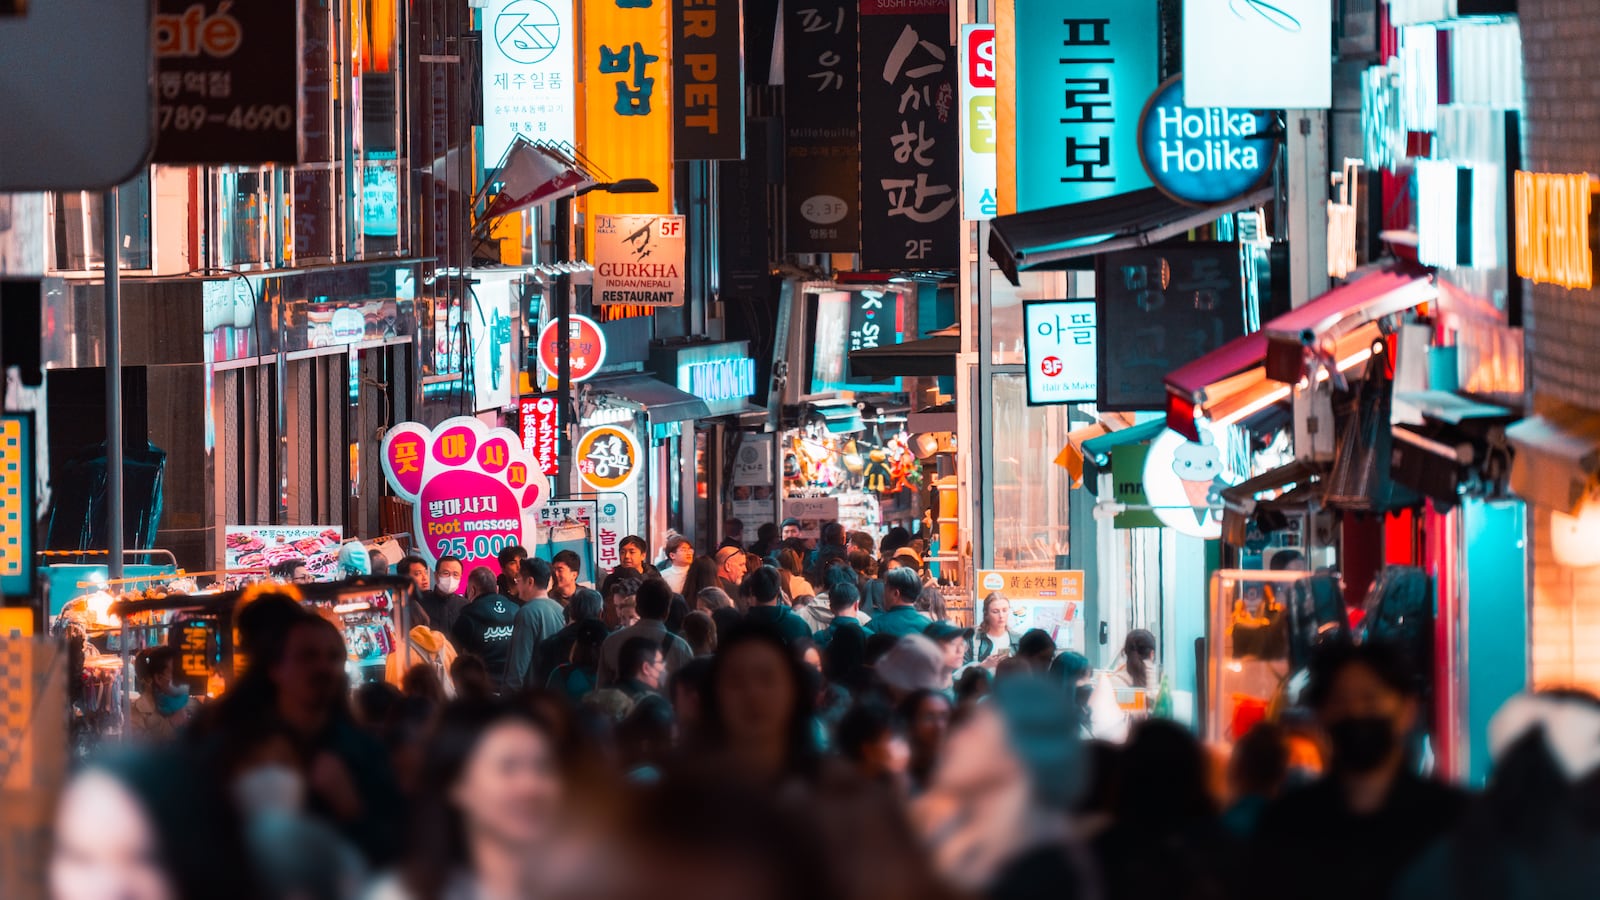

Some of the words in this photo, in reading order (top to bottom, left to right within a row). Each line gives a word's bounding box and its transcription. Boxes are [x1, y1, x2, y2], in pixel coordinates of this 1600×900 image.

[493, 72, 562, 90] 제주일품
[684, 53, 718, 134] PET
[1060, 18, 1116, 183] 프로보
[1157, 106, 1257, 139] Holika
[1158, 140, 1259, 173] Holika
[661, 222, 679, 235] 5F
[905, 239, 933, 260] 2F
[598, 262, 679, 278] GURKHA
[605, 279, 671, 288] INDIAN/NEPALI
[602, 291, 674, 302] RESTAURANT
[1037, 313, 1097, 345] 아뜰
[1042, 359, 1063, 374] 3F
[1043, 383, 1060, 392] Hair
[1063, 382, 1070, 391] &
[522, 403, 537, 414] 2F
[429, 496, 497, 518] 발마사지
[428, 518, 461, 536] Foot
[463, 519, 519, 532] massage
